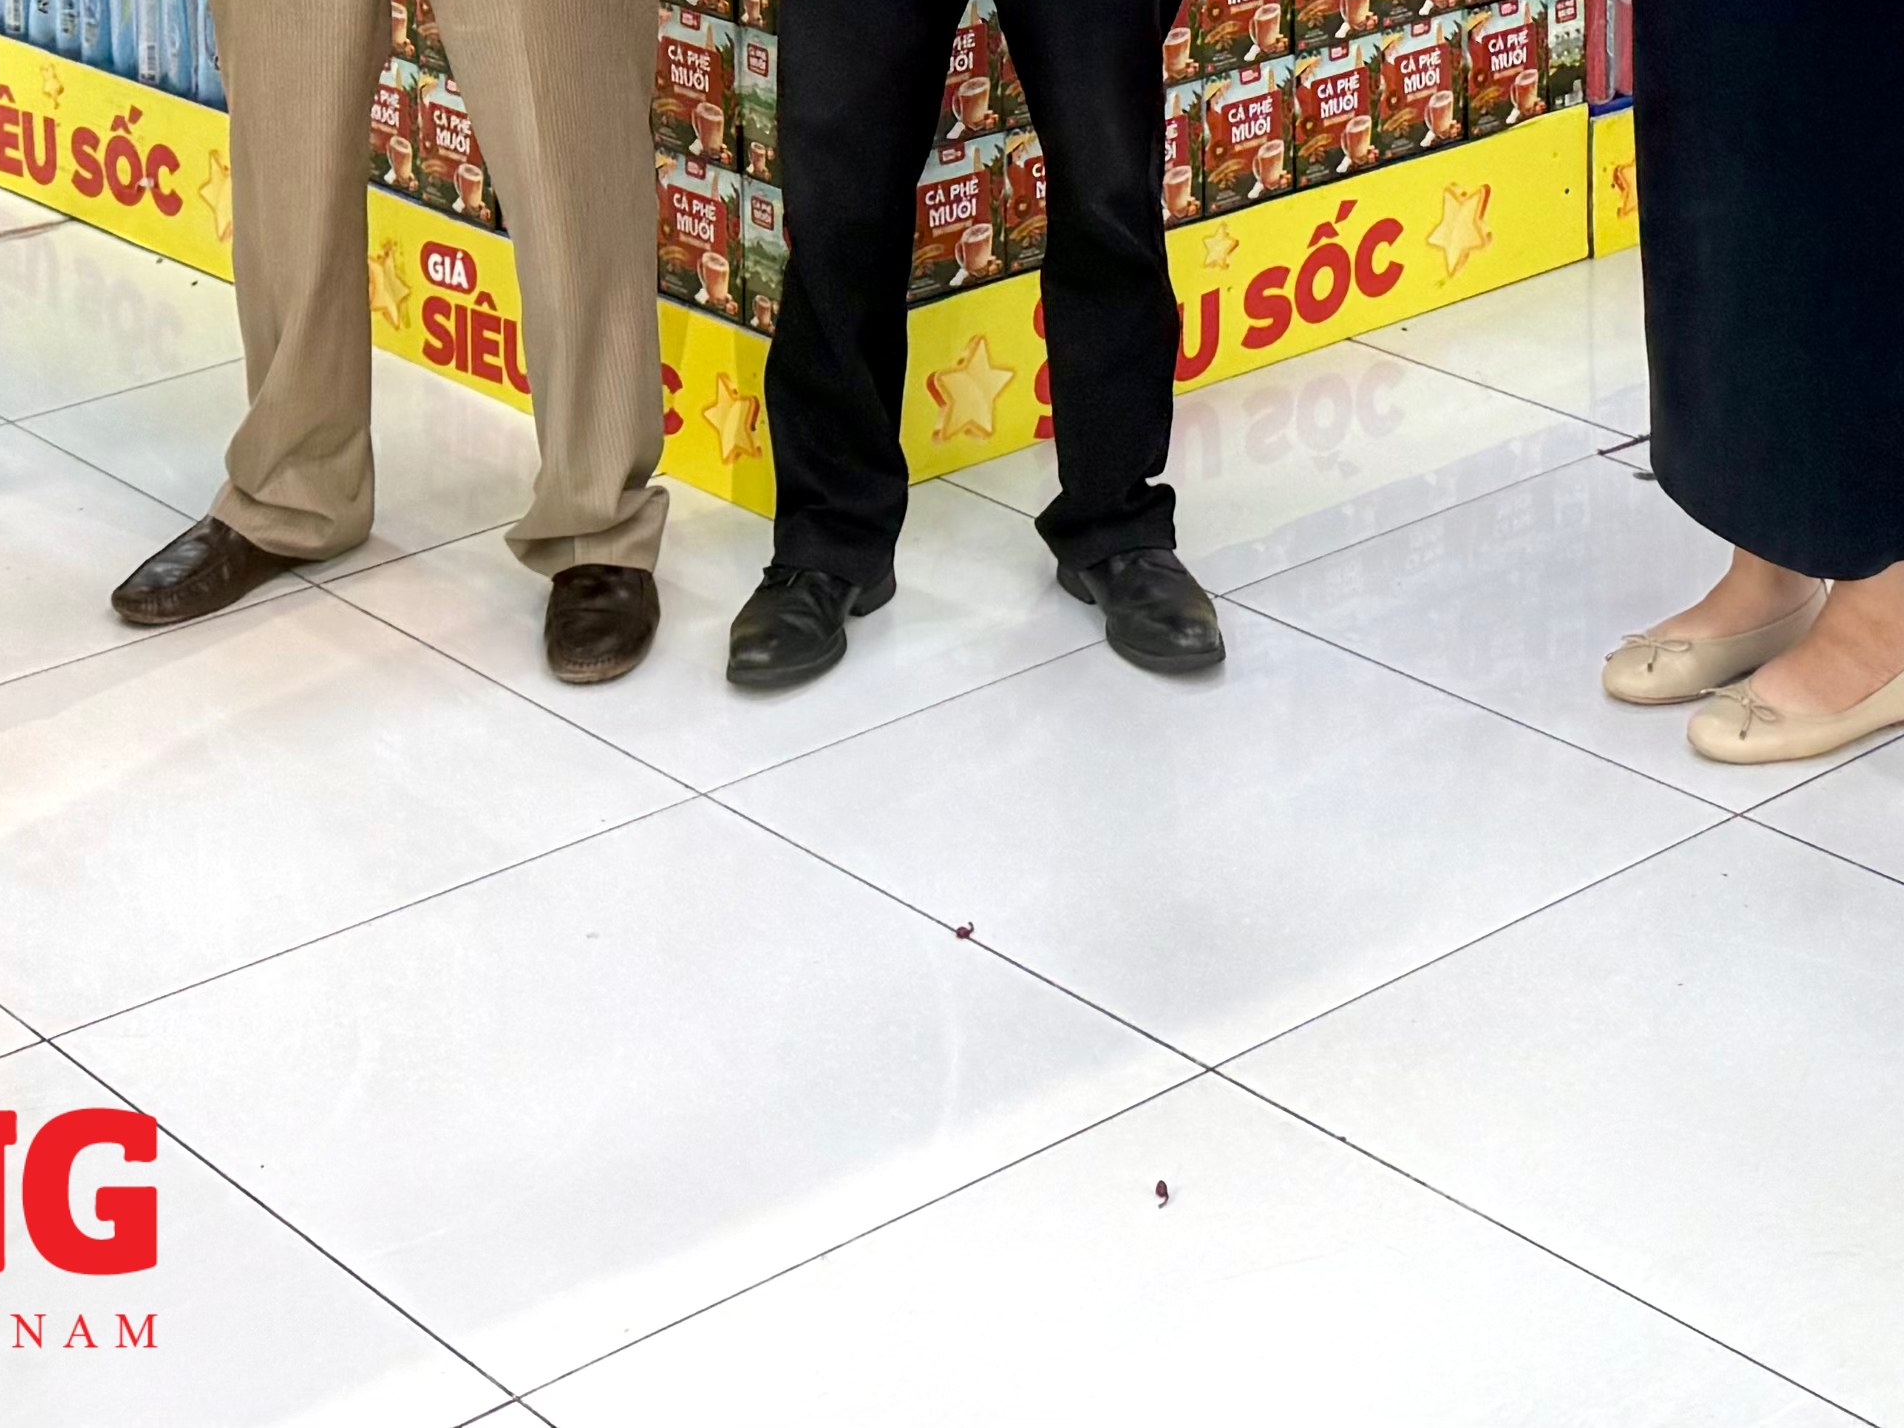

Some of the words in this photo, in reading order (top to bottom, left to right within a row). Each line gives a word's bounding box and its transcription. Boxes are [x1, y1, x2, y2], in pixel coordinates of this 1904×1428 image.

[669, 45, 689, 64] CÀ
[1227, 109, 1246, 127] CÀ
[71, 104, 183, 217] SỐC
[427, 249, 470, 289] GIÁ
[1240, 199, 1405, 351] SỐC
